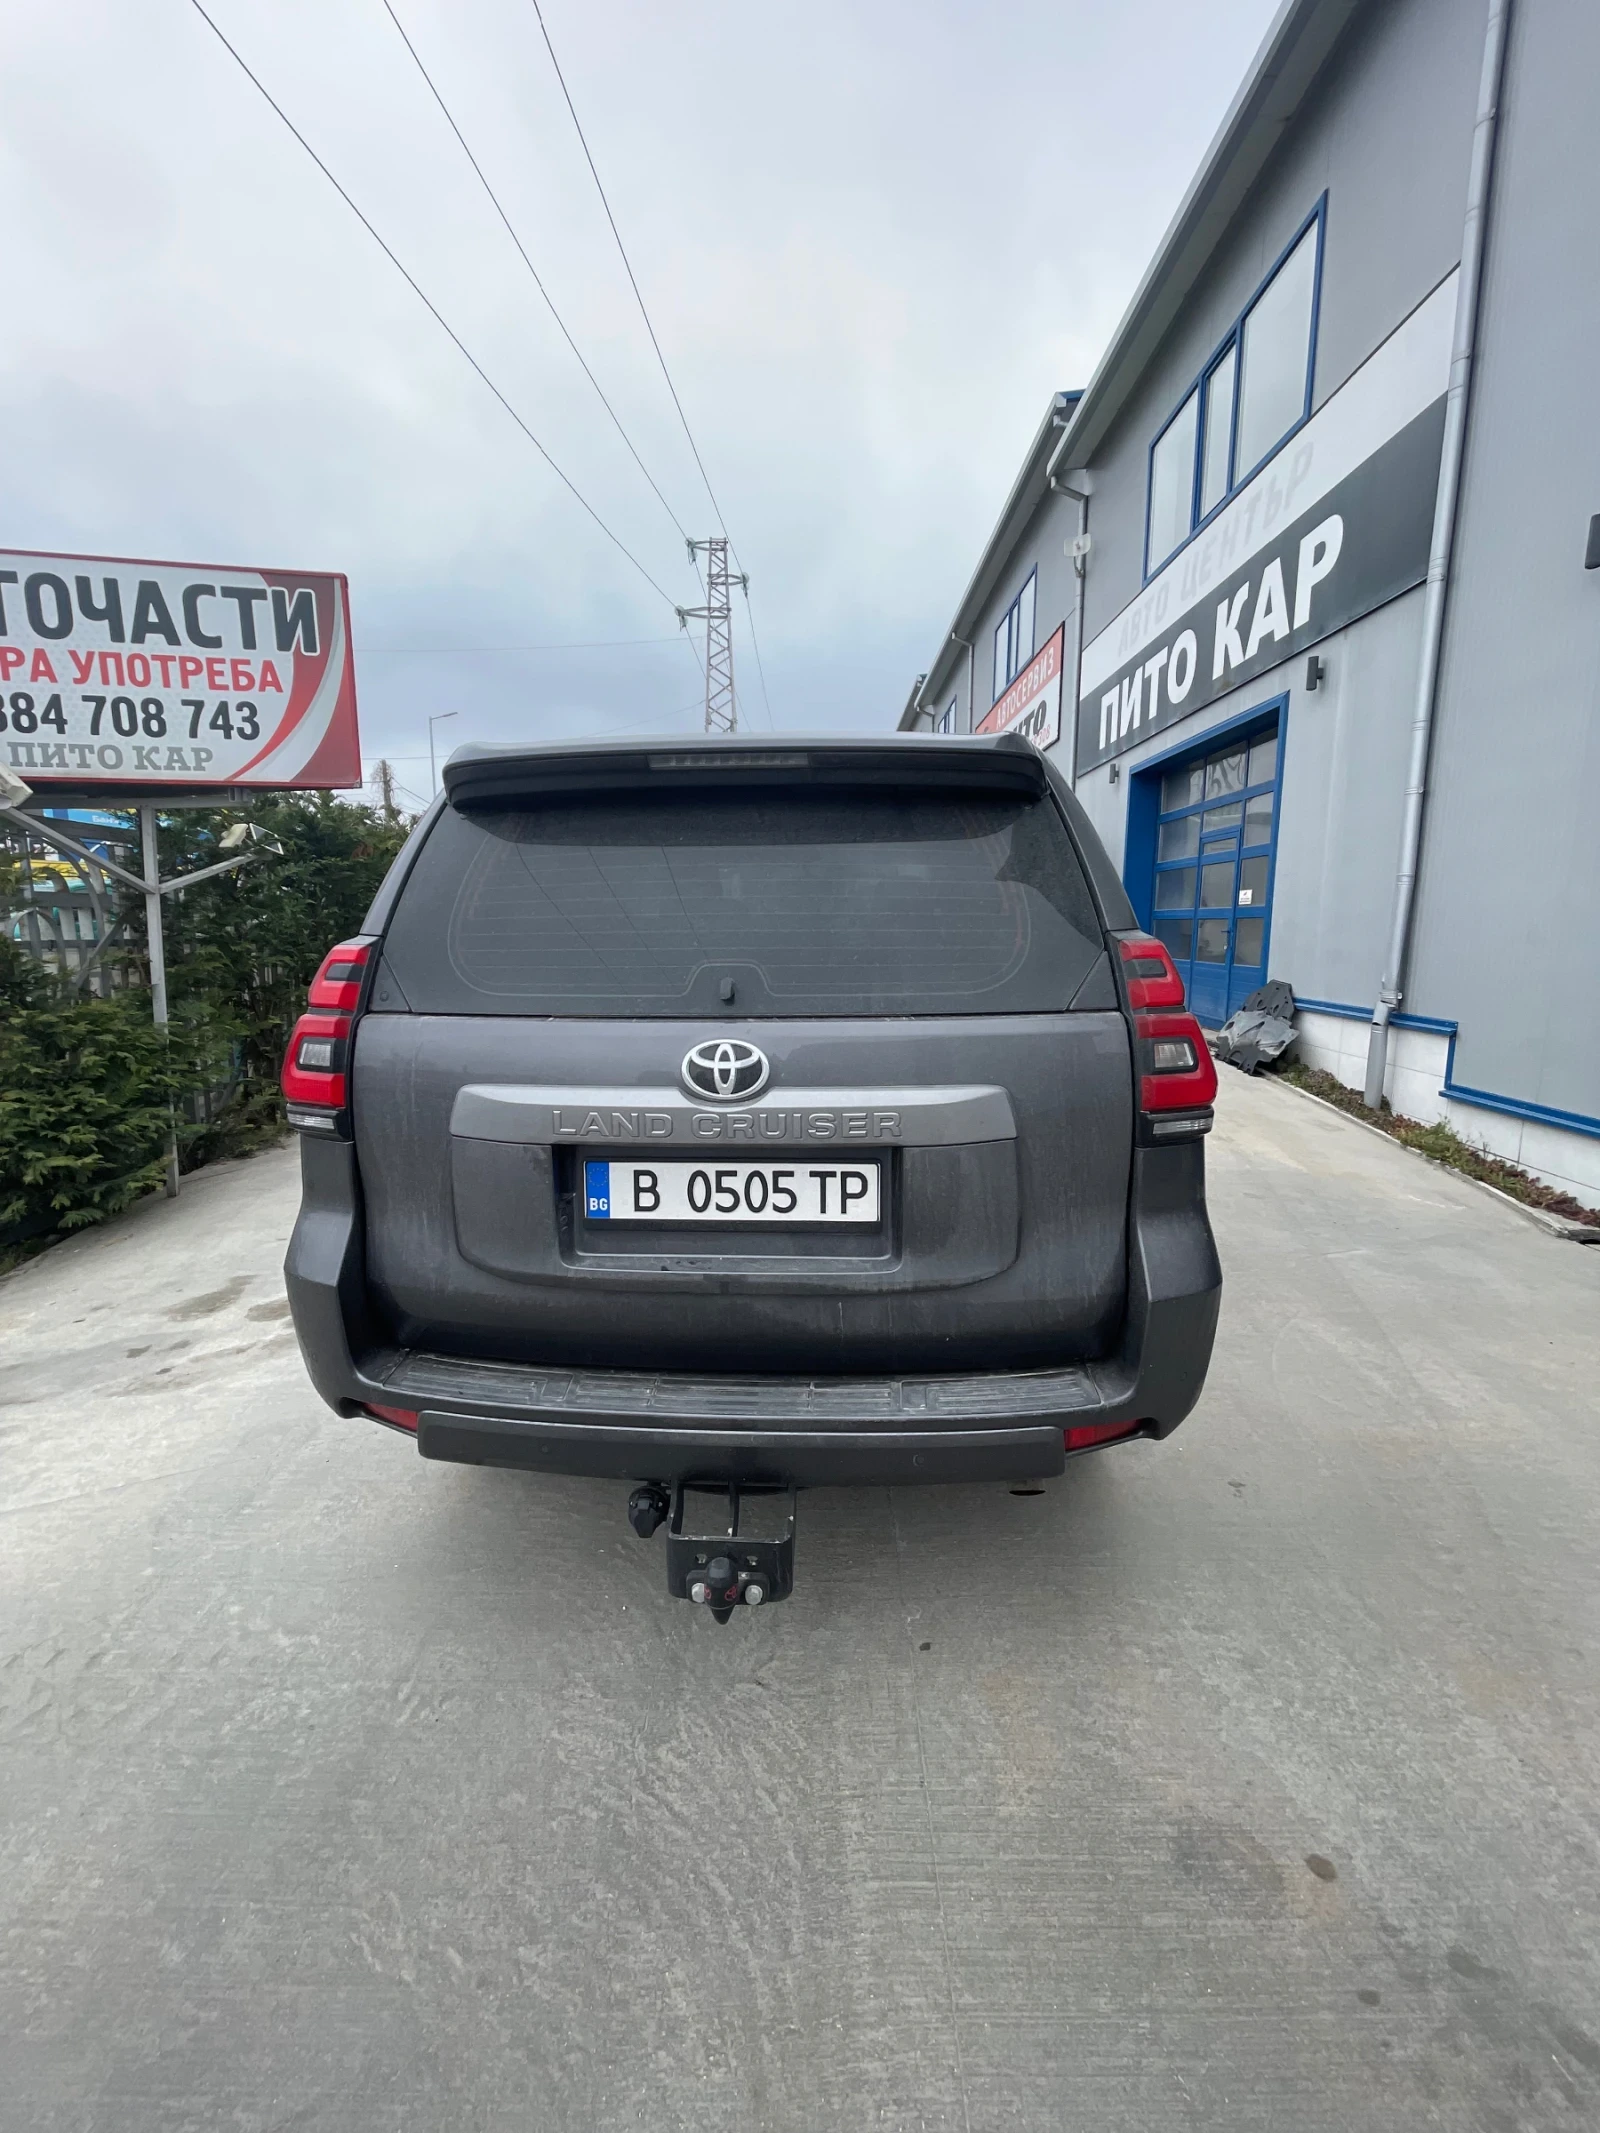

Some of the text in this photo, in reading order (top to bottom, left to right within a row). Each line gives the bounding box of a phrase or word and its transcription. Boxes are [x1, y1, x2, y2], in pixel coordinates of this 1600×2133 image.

[1099, 514, 1344, 750] ПИТО КАР
[1118, 580, 1170, 657] АВТО
[67, 649, 284, 693] УПОТРЕБА
[81, 695, 167, 738] 708
[180, 699, 260, 740] 743
[7, 741, 214, 771] ПИТО КАР
[552, 1110, 903, 1139] LAND CRUISER
[589, 1197, 608, 1211] BG
[634, 1169, 868, 1214] B 0505 TP
